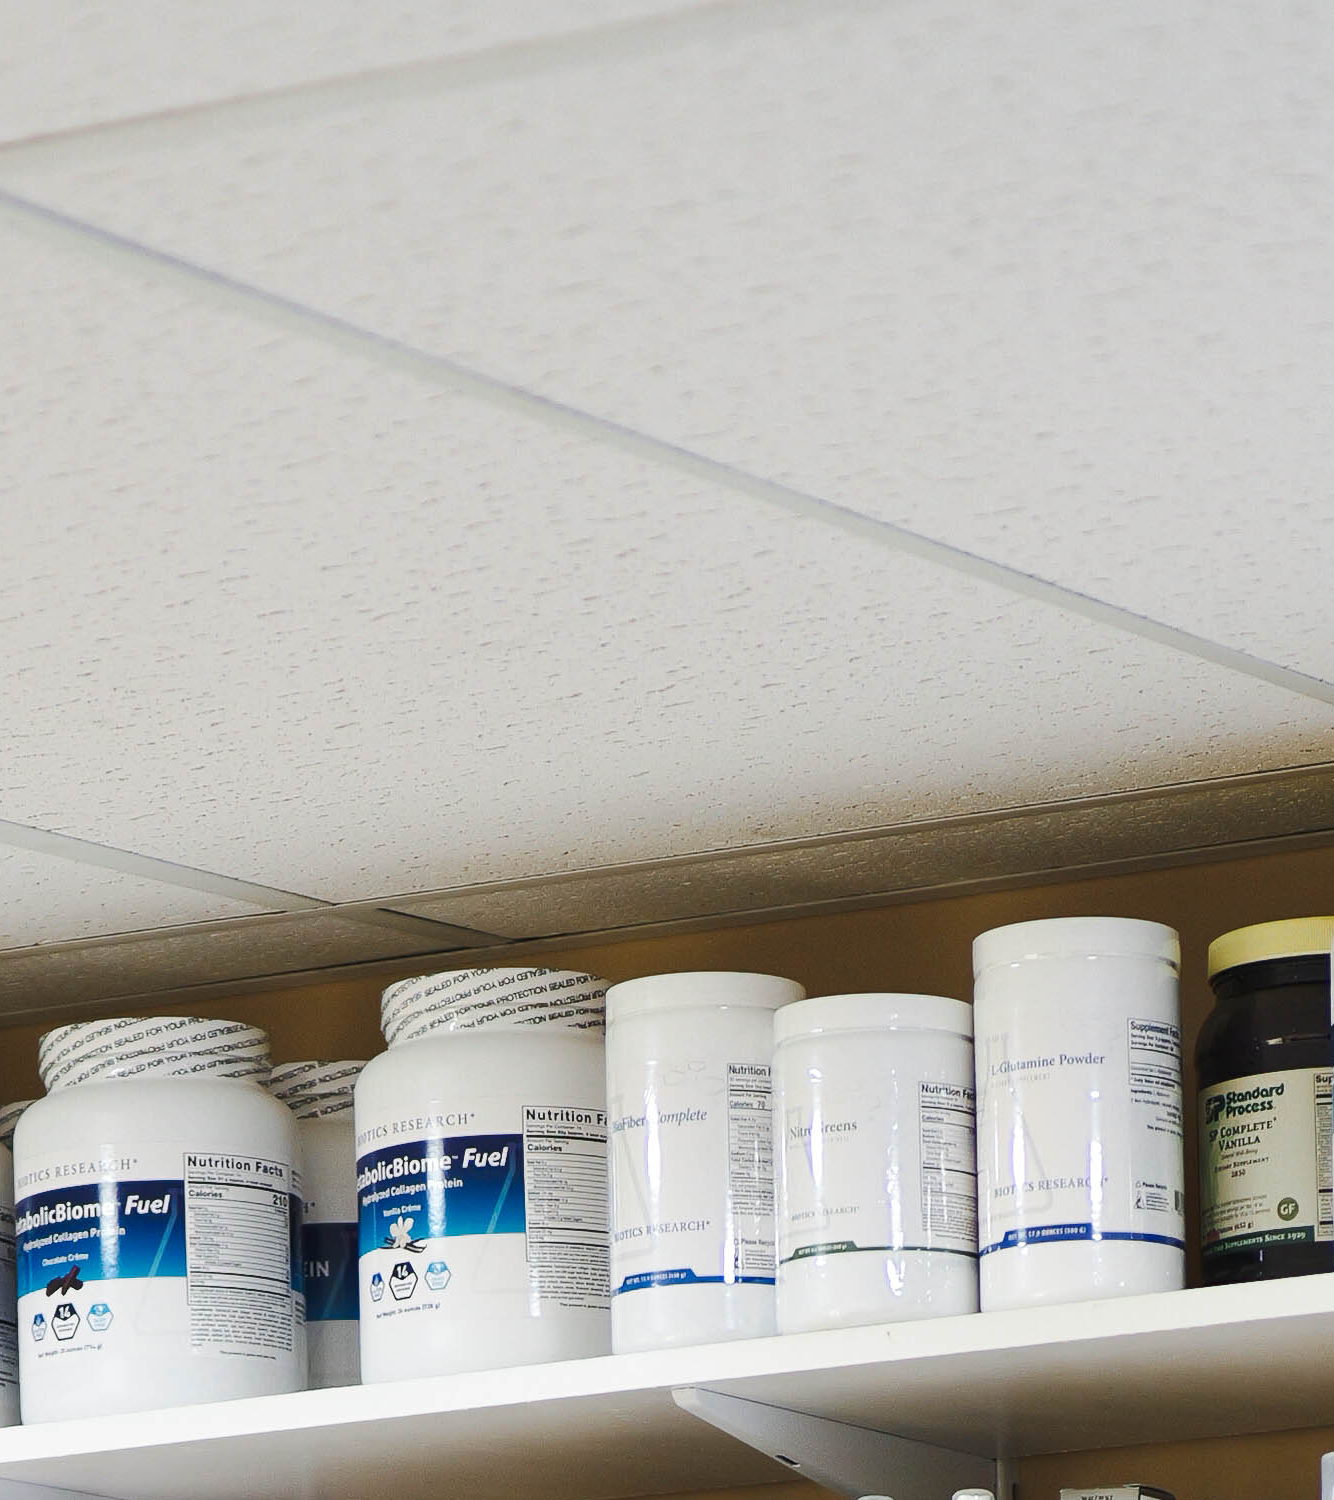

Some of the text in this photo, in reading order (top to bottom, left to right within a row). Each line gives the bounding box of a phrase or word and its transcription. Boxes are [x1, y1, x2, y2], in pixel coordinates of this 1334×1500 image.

[1059, 1052, 1106, 1067] Powder
[1226, 1084, 1285, 1100] Standard
[1226, 1100, 1275, 1114] Process
[392, 1113, 469, 1133] RESEARCH
[526, 1109, 590, 1125] Nutrition
[187, 1155, 284, 1178] Nutrition Facts
[462, 1147, 509, 1171] Fuel
[188, 1189, 223, 1201] Calories
[123, 1195, 171, 1217] Fuel
[1280, 1202, 1297, 1216] GF
